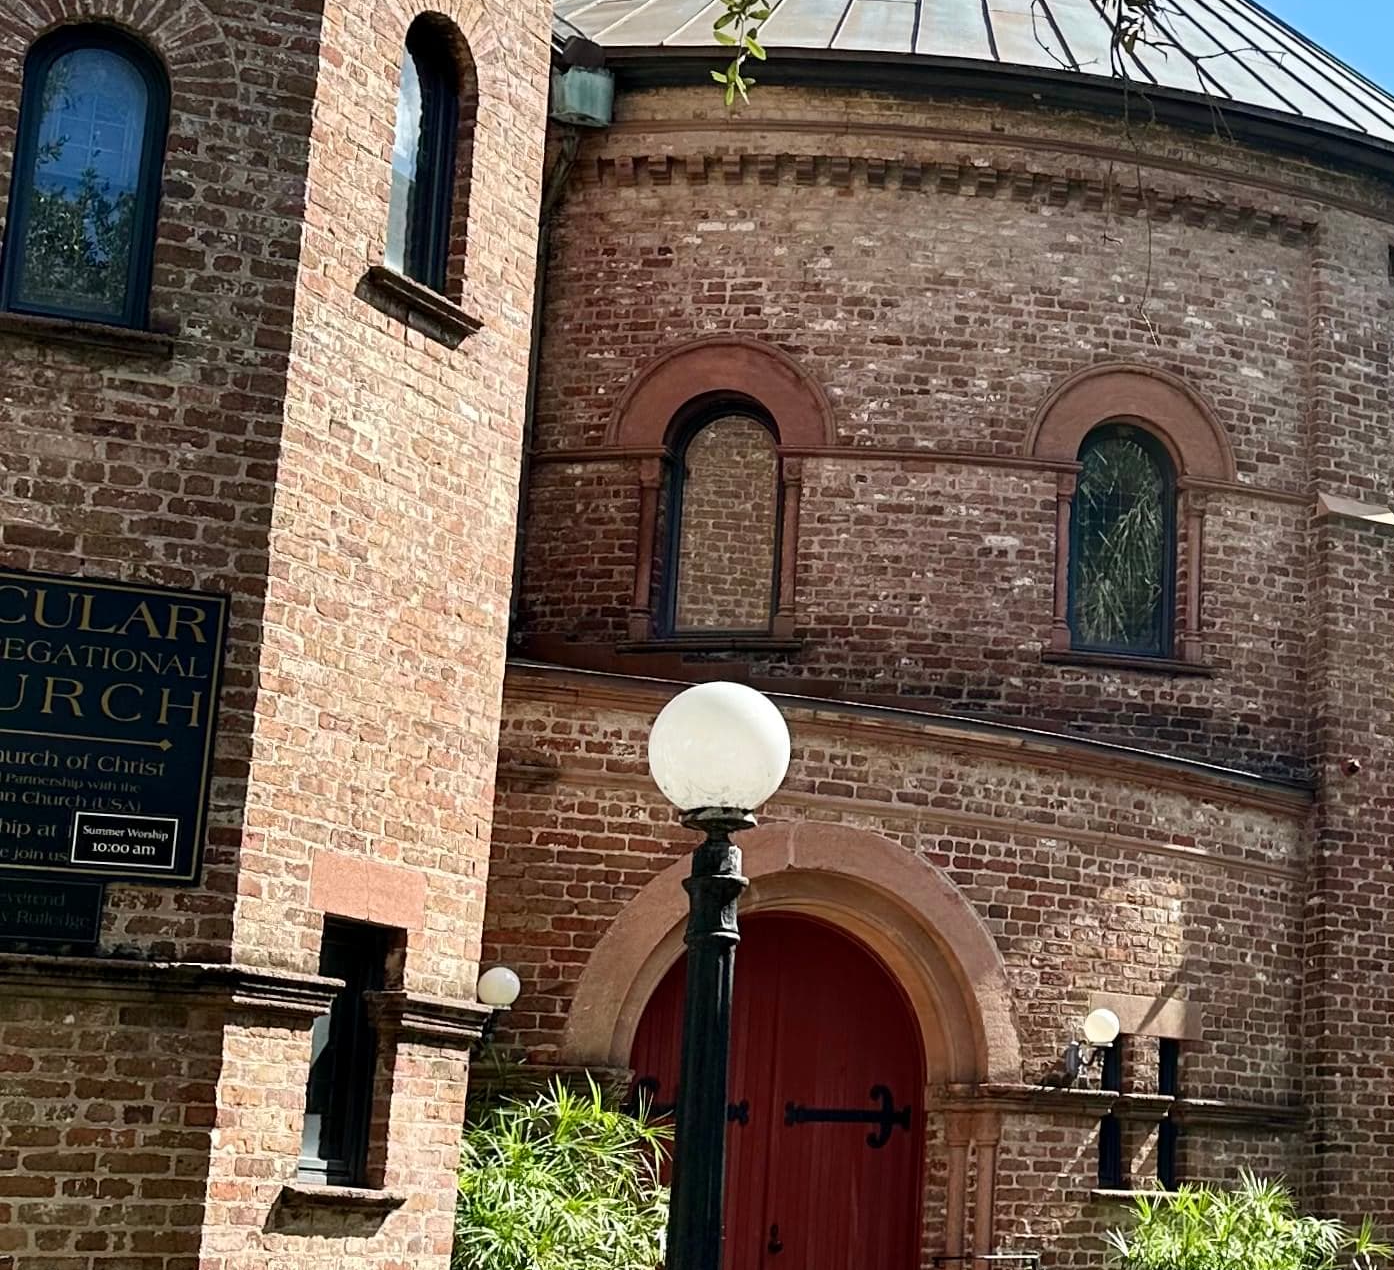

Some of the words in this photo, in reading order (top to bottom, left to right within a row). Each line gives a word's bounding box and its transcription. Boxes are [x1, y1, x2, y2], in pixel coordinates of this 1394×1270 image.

[0, 636, 208, 679] EGATIONAL
[66, 752, 92, 770] of
[97, 754, 166, 777] Christ
[5, 771, 85, 791] Partnership
[87, 777, 118, 793] with
[120, 780, 142, 794] the
[21, 790, 87, 809] Church
[37, 823, 58, 838] at
[82, 824, 125, 837] Summer
[126, 827, 169, 842] Worship
[91, 842, 130, 854] 10:00
[132, 844, 156, 856] am
